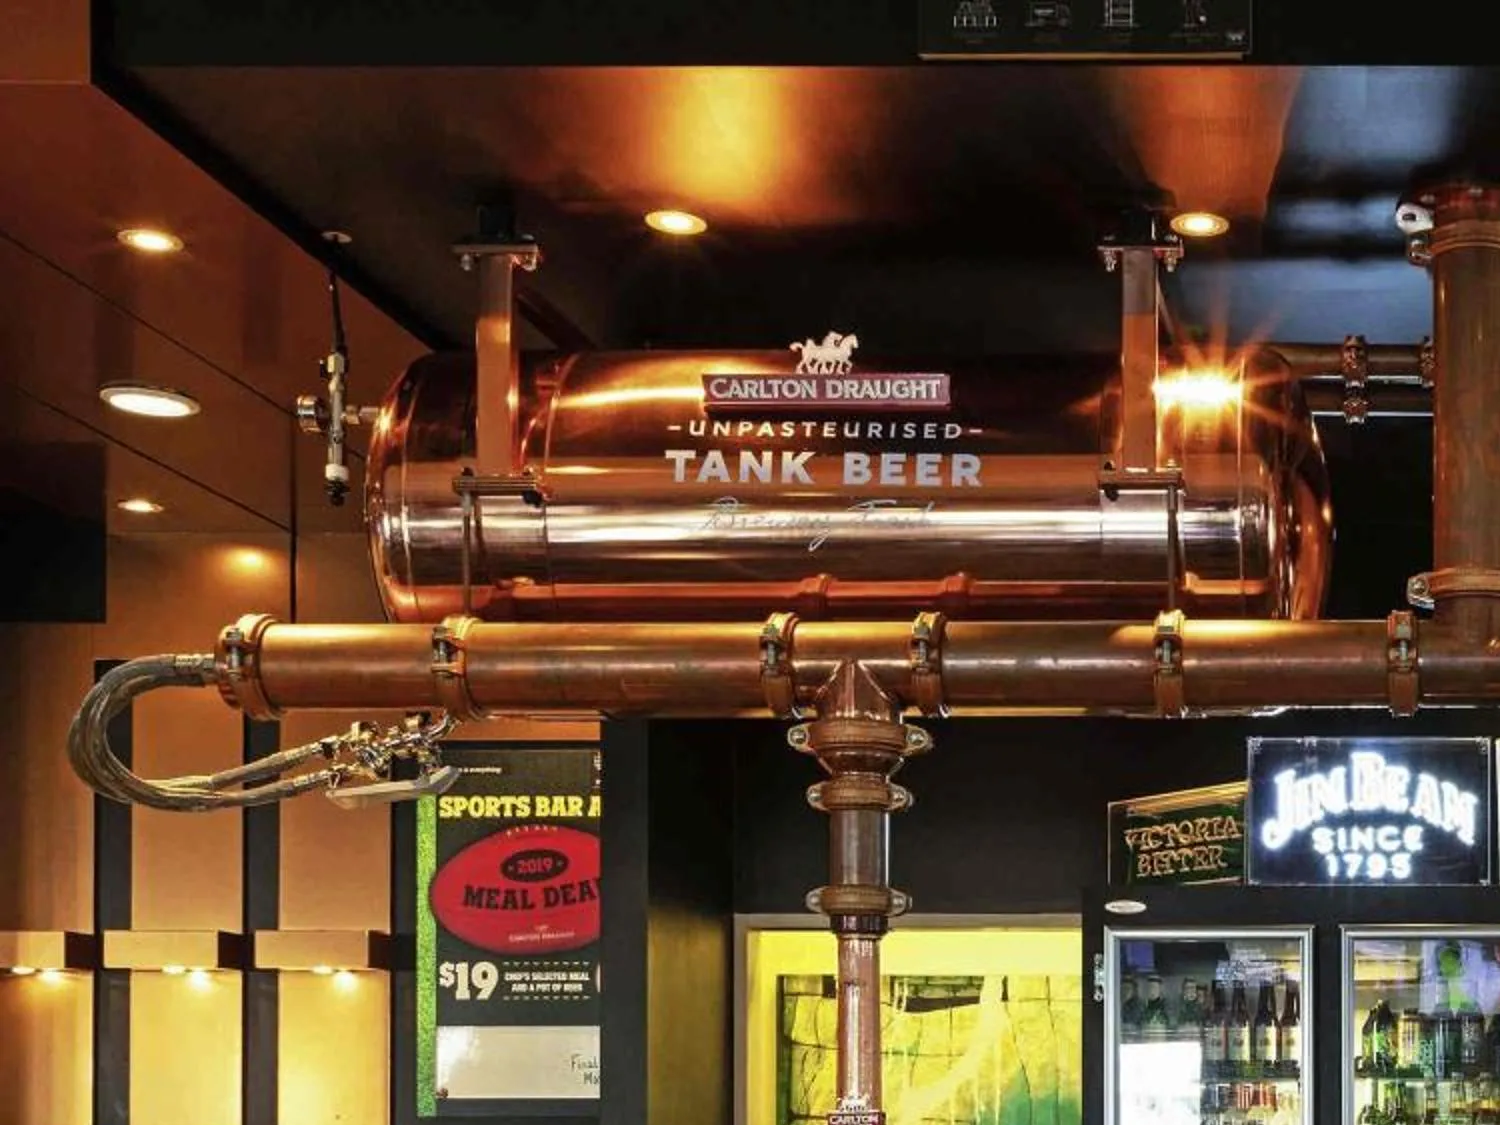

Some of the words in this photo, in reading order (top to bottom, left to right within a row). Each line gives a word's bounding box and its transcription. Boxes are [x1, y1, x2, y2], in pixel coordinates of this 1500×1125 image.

[709, 378, 817, 399] CARLTON
[825, 379, 943, 400] DRAUGHT
[665, 449, 816, 485] TANK
[842, 451, 982, 488] BEER
[439, 795, 531, 818] SPORTS
[535, 795, 583, 817] BAR
[1350, 751, 1477, 847] BEAM
[1123, 815, 1243, 850] VICTORIA
[1311, 824, 1424, 854] SINCE
[516, 857, 553, 875] 2019
[1136, 844, 1229, 877] BITTER
[1325, 853, 1412, 879] 1795
[462, 884, 535, 910] MEAL
[543, 877, 601, 908] DEA
[439, 961, 499, 1001] $19
[829, 1112, 879, 1125] CARLTON
